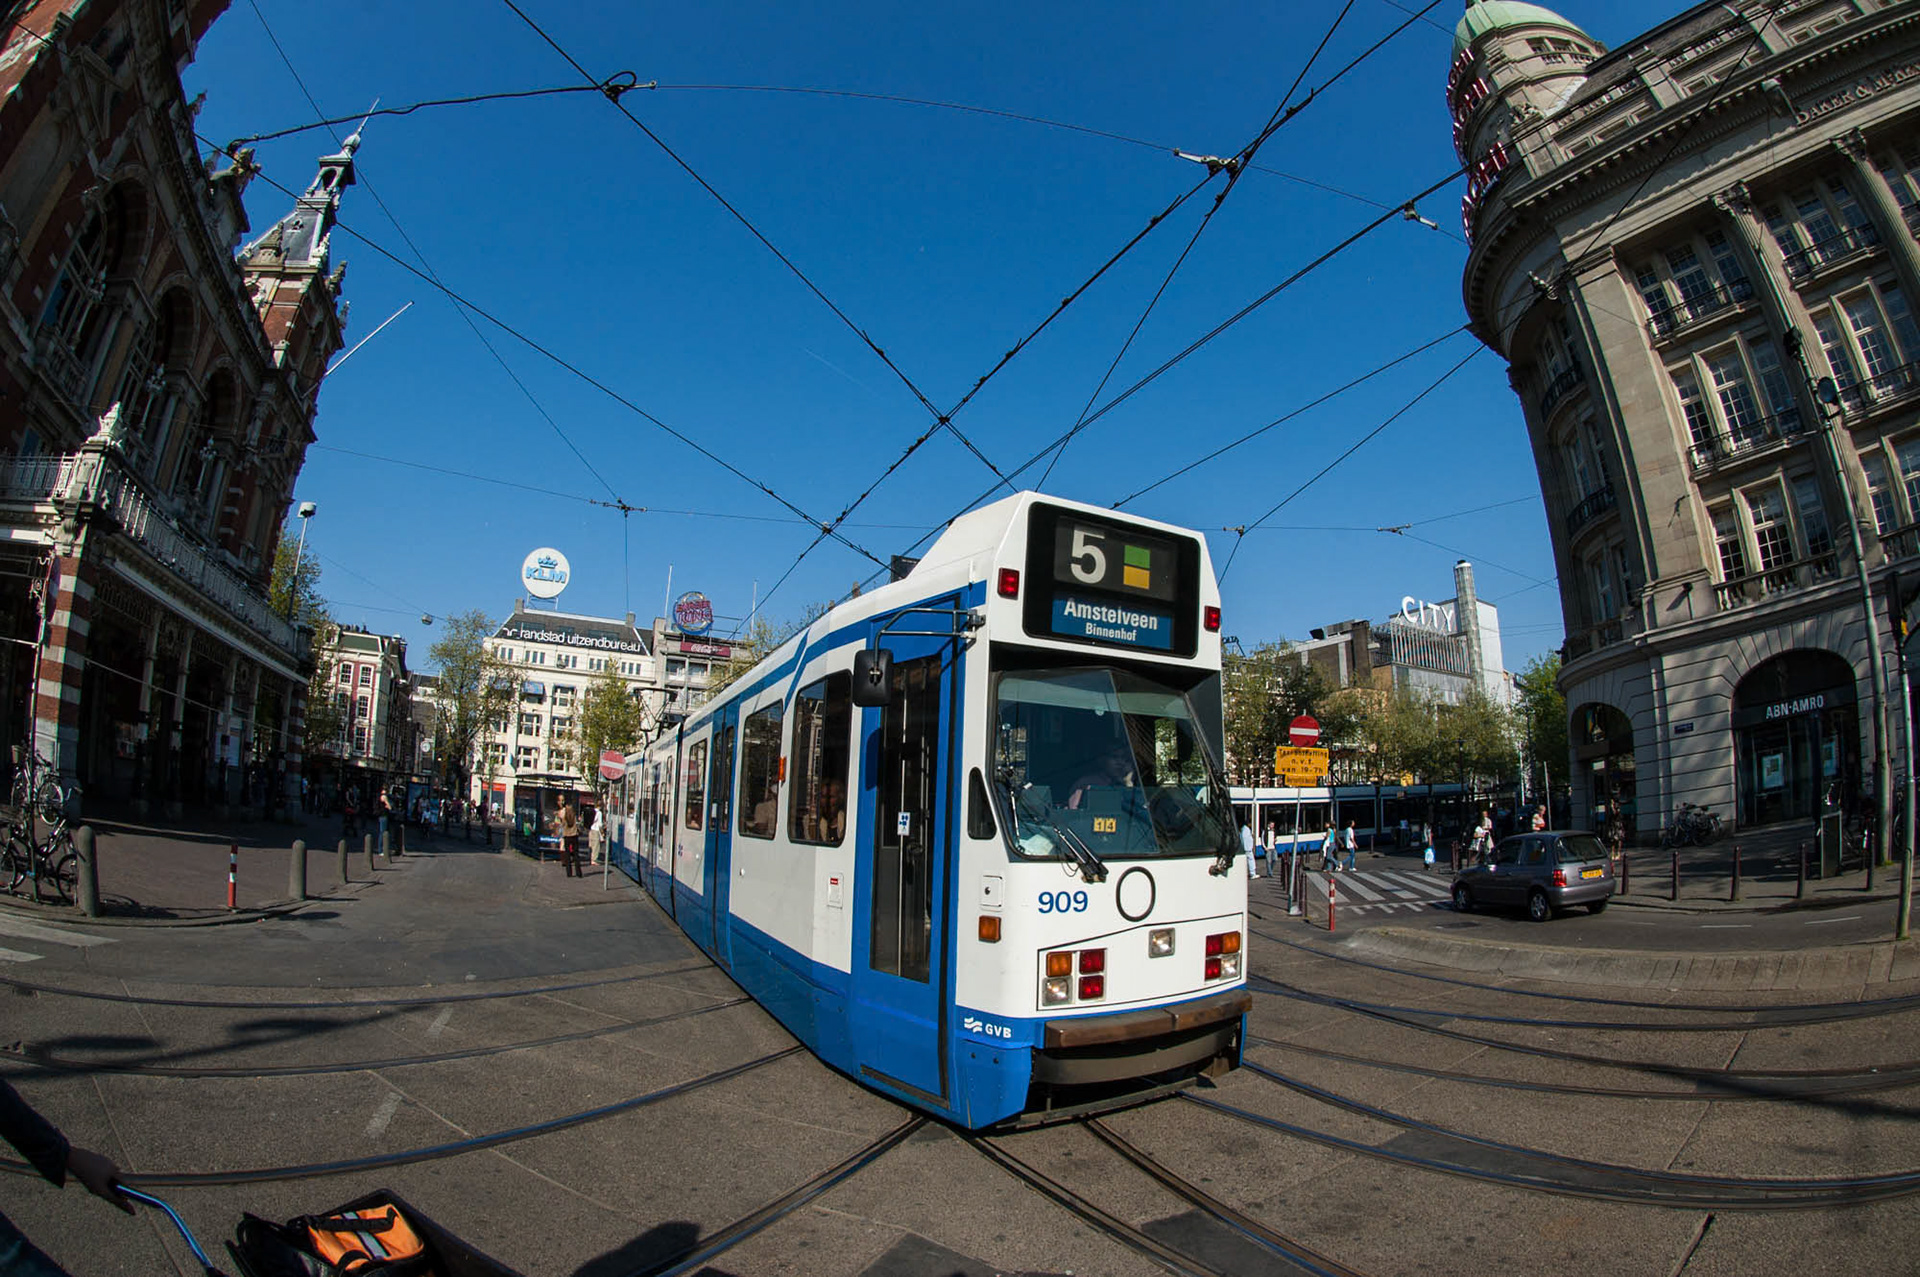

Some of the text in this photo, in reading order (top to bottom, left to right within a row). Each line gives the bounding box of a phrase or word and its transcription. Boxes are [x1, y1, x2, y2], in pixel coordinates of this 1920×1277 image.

[1070, 529, 1107, 584] 5
[526, 565, 567, 584] KLM
[1063, 598, 1158, 630] Amstelveen
[1401, 595, 1455, 632] CITY
[520, 629, 641, 653] randstad uitzendbureau
[1085, 621, 1137, 641] Binnenhof
[1037, 890, 1089, 914] 909
[984, 1023, 1012, 1039] GVB
